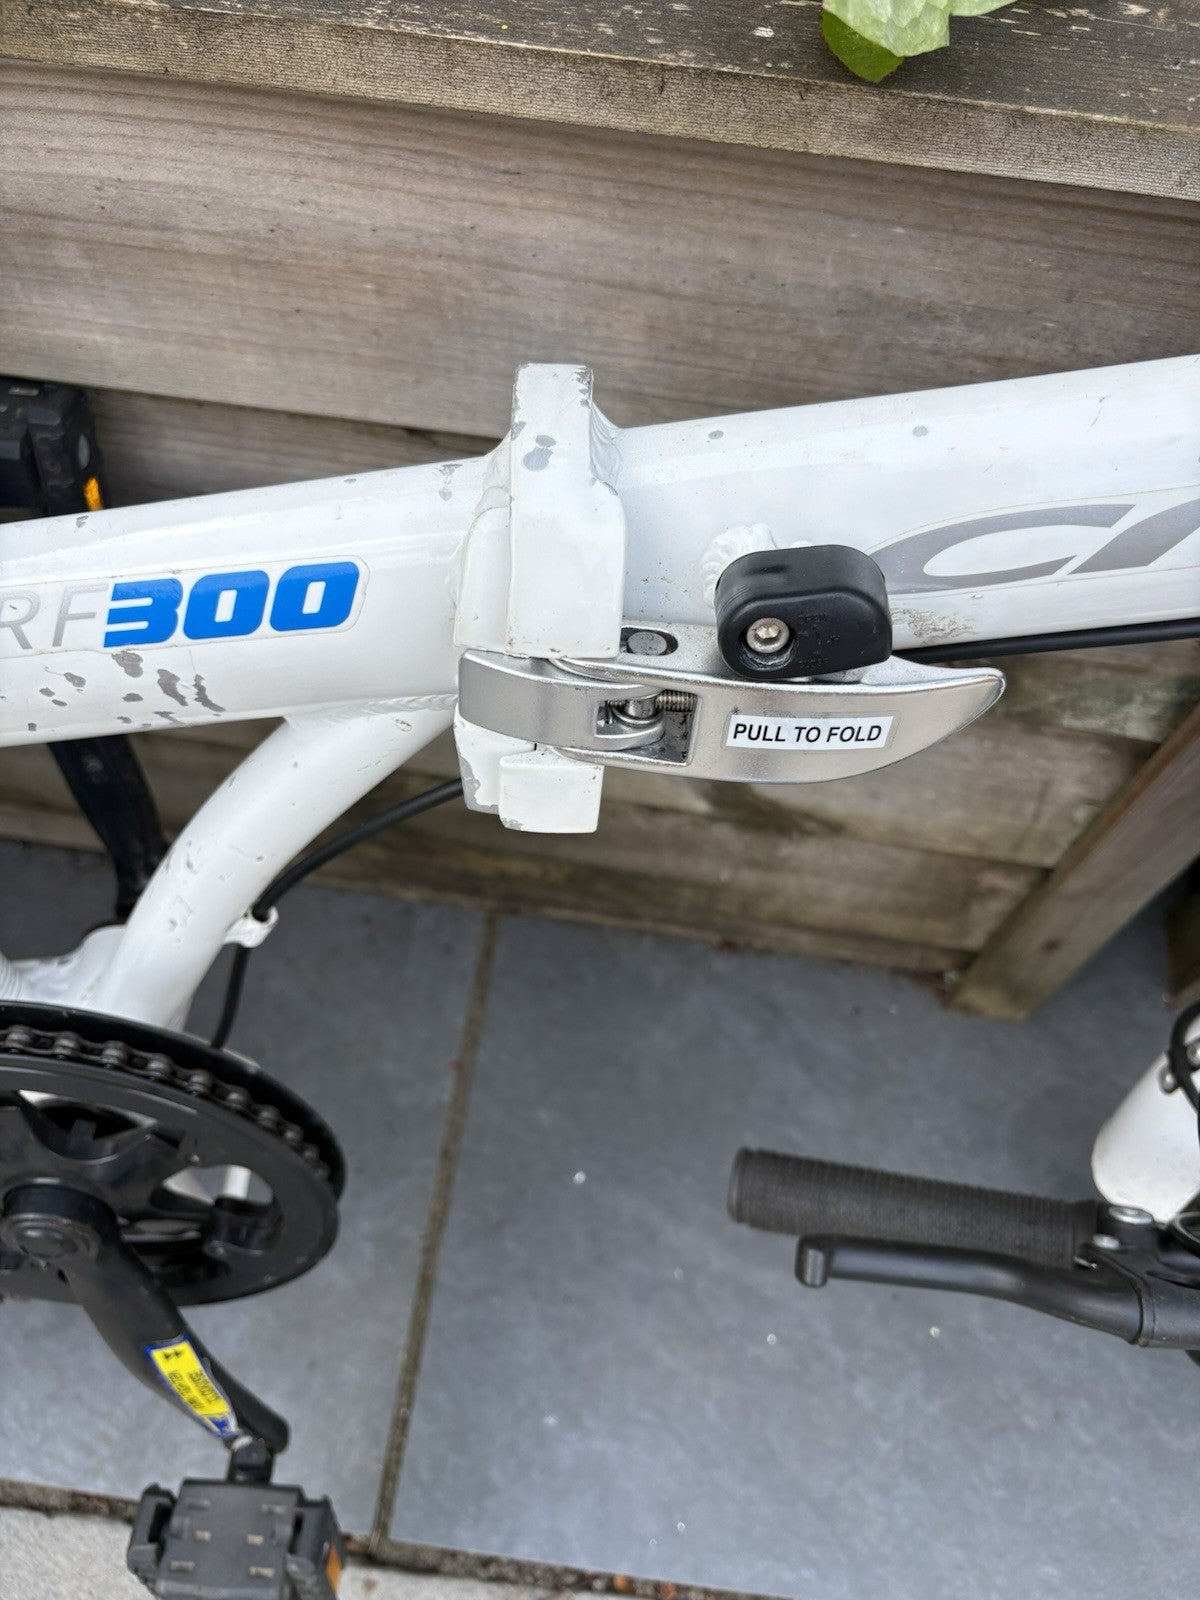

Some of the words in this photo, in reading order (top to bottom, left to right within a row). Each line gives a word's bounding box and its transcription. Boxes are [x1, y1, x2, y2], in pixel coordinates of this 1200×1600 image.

[733, 723, 786, 742] PULL
[795, 726, 821, 743] TO
[826, 725, 882, 743] FOLD
